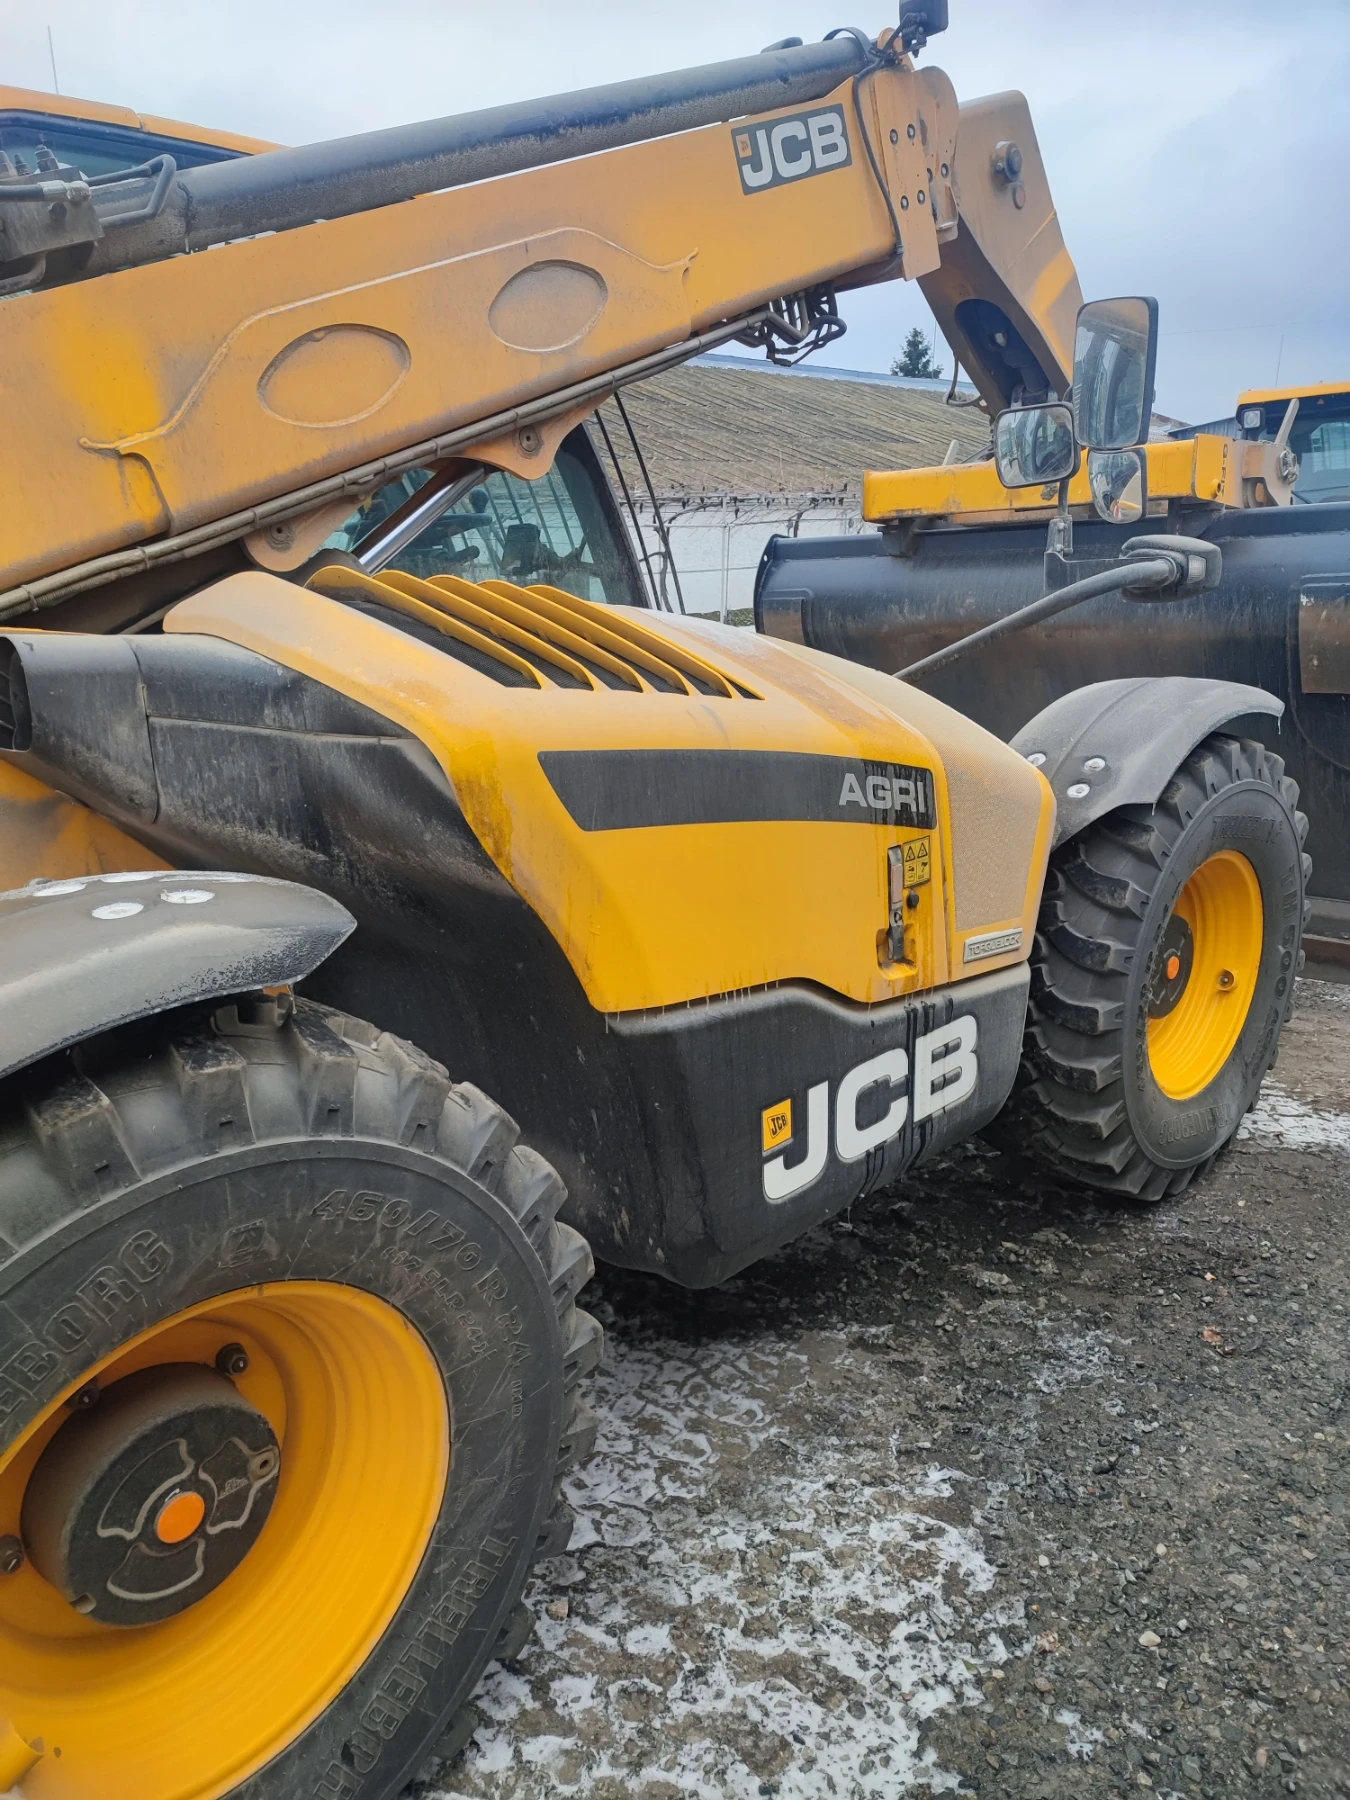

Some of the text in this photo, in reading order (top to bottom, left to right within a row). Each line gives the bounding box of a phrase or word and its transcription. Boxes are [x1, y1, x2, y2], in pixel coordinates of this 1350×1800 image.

[742, 112, 847, 187] JCB
[839, 772, 926, 813] AGRI
[763, 1015, 978, 1200] JCB
[770, 1112, 788, 1136] JCB
[311, 1189, 482, 1271] 460/70
[474, 1267, 508, 1307] R
